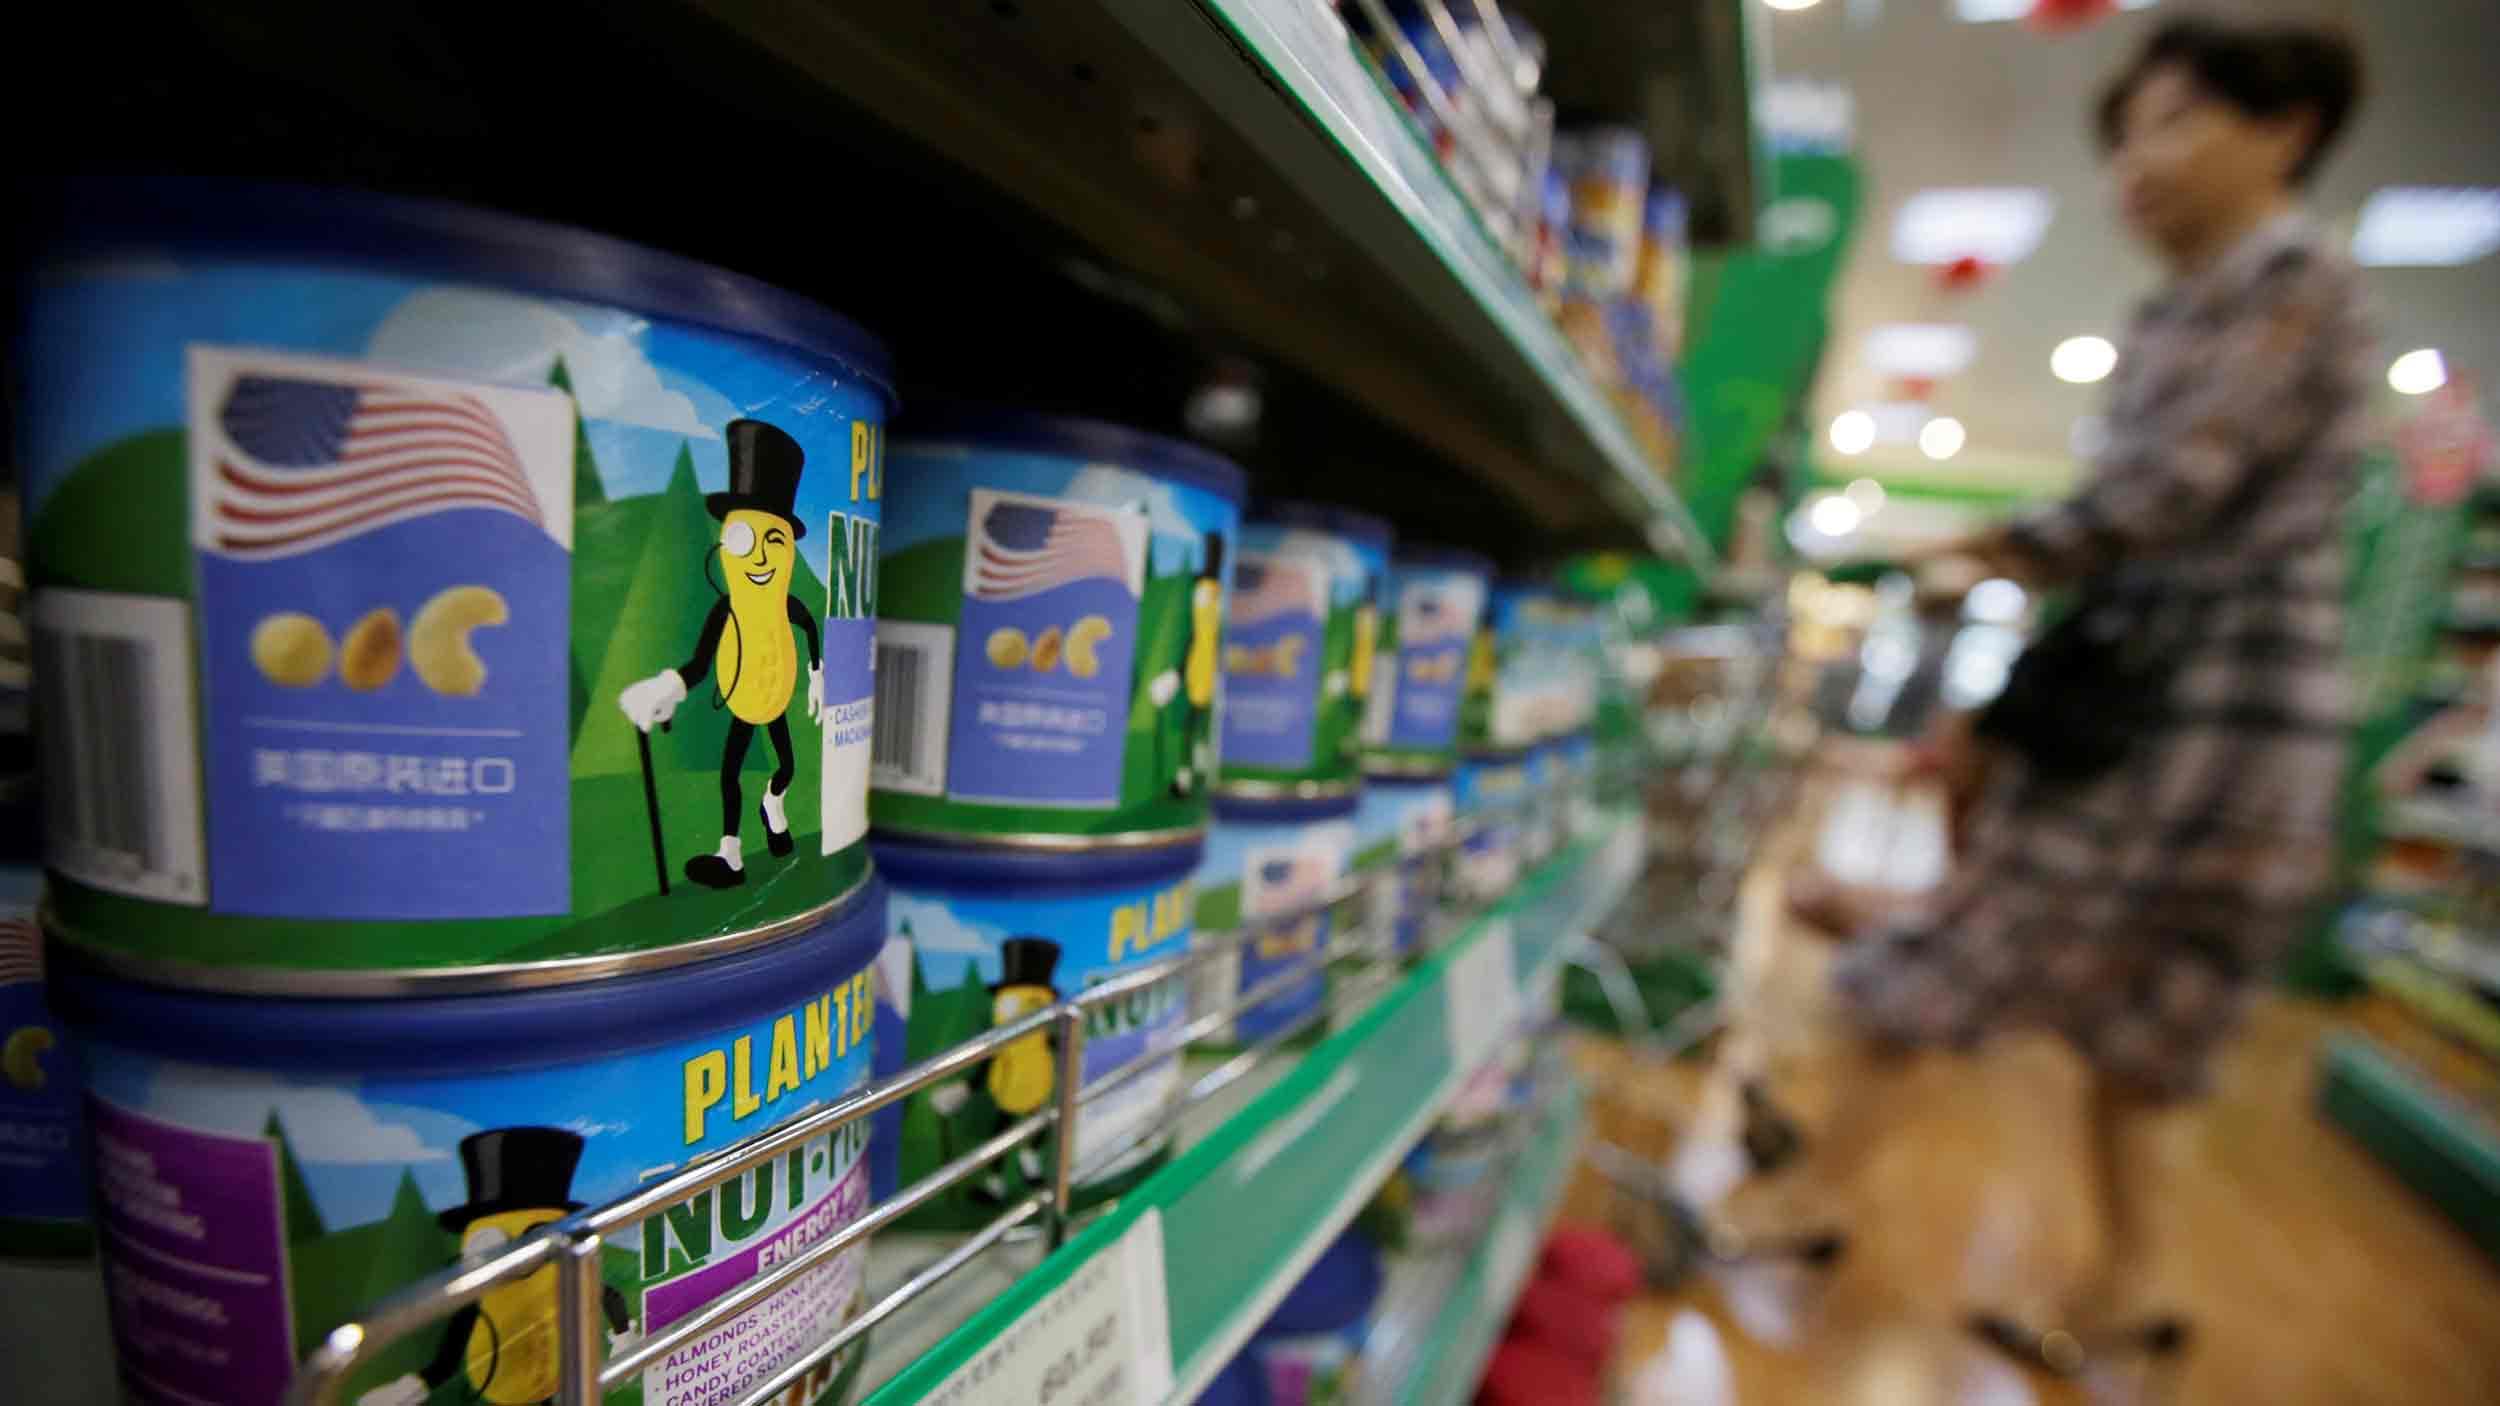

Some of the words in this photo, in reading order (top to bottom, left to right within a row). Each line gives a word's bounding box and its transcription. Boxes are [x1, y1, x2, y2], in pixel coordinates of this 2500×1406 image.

[665, 1313, 758, 1371] ALMONDS
[665, 1346, 733, 1391] HONEY
[666, 1367, 732, 1406] CANDY
